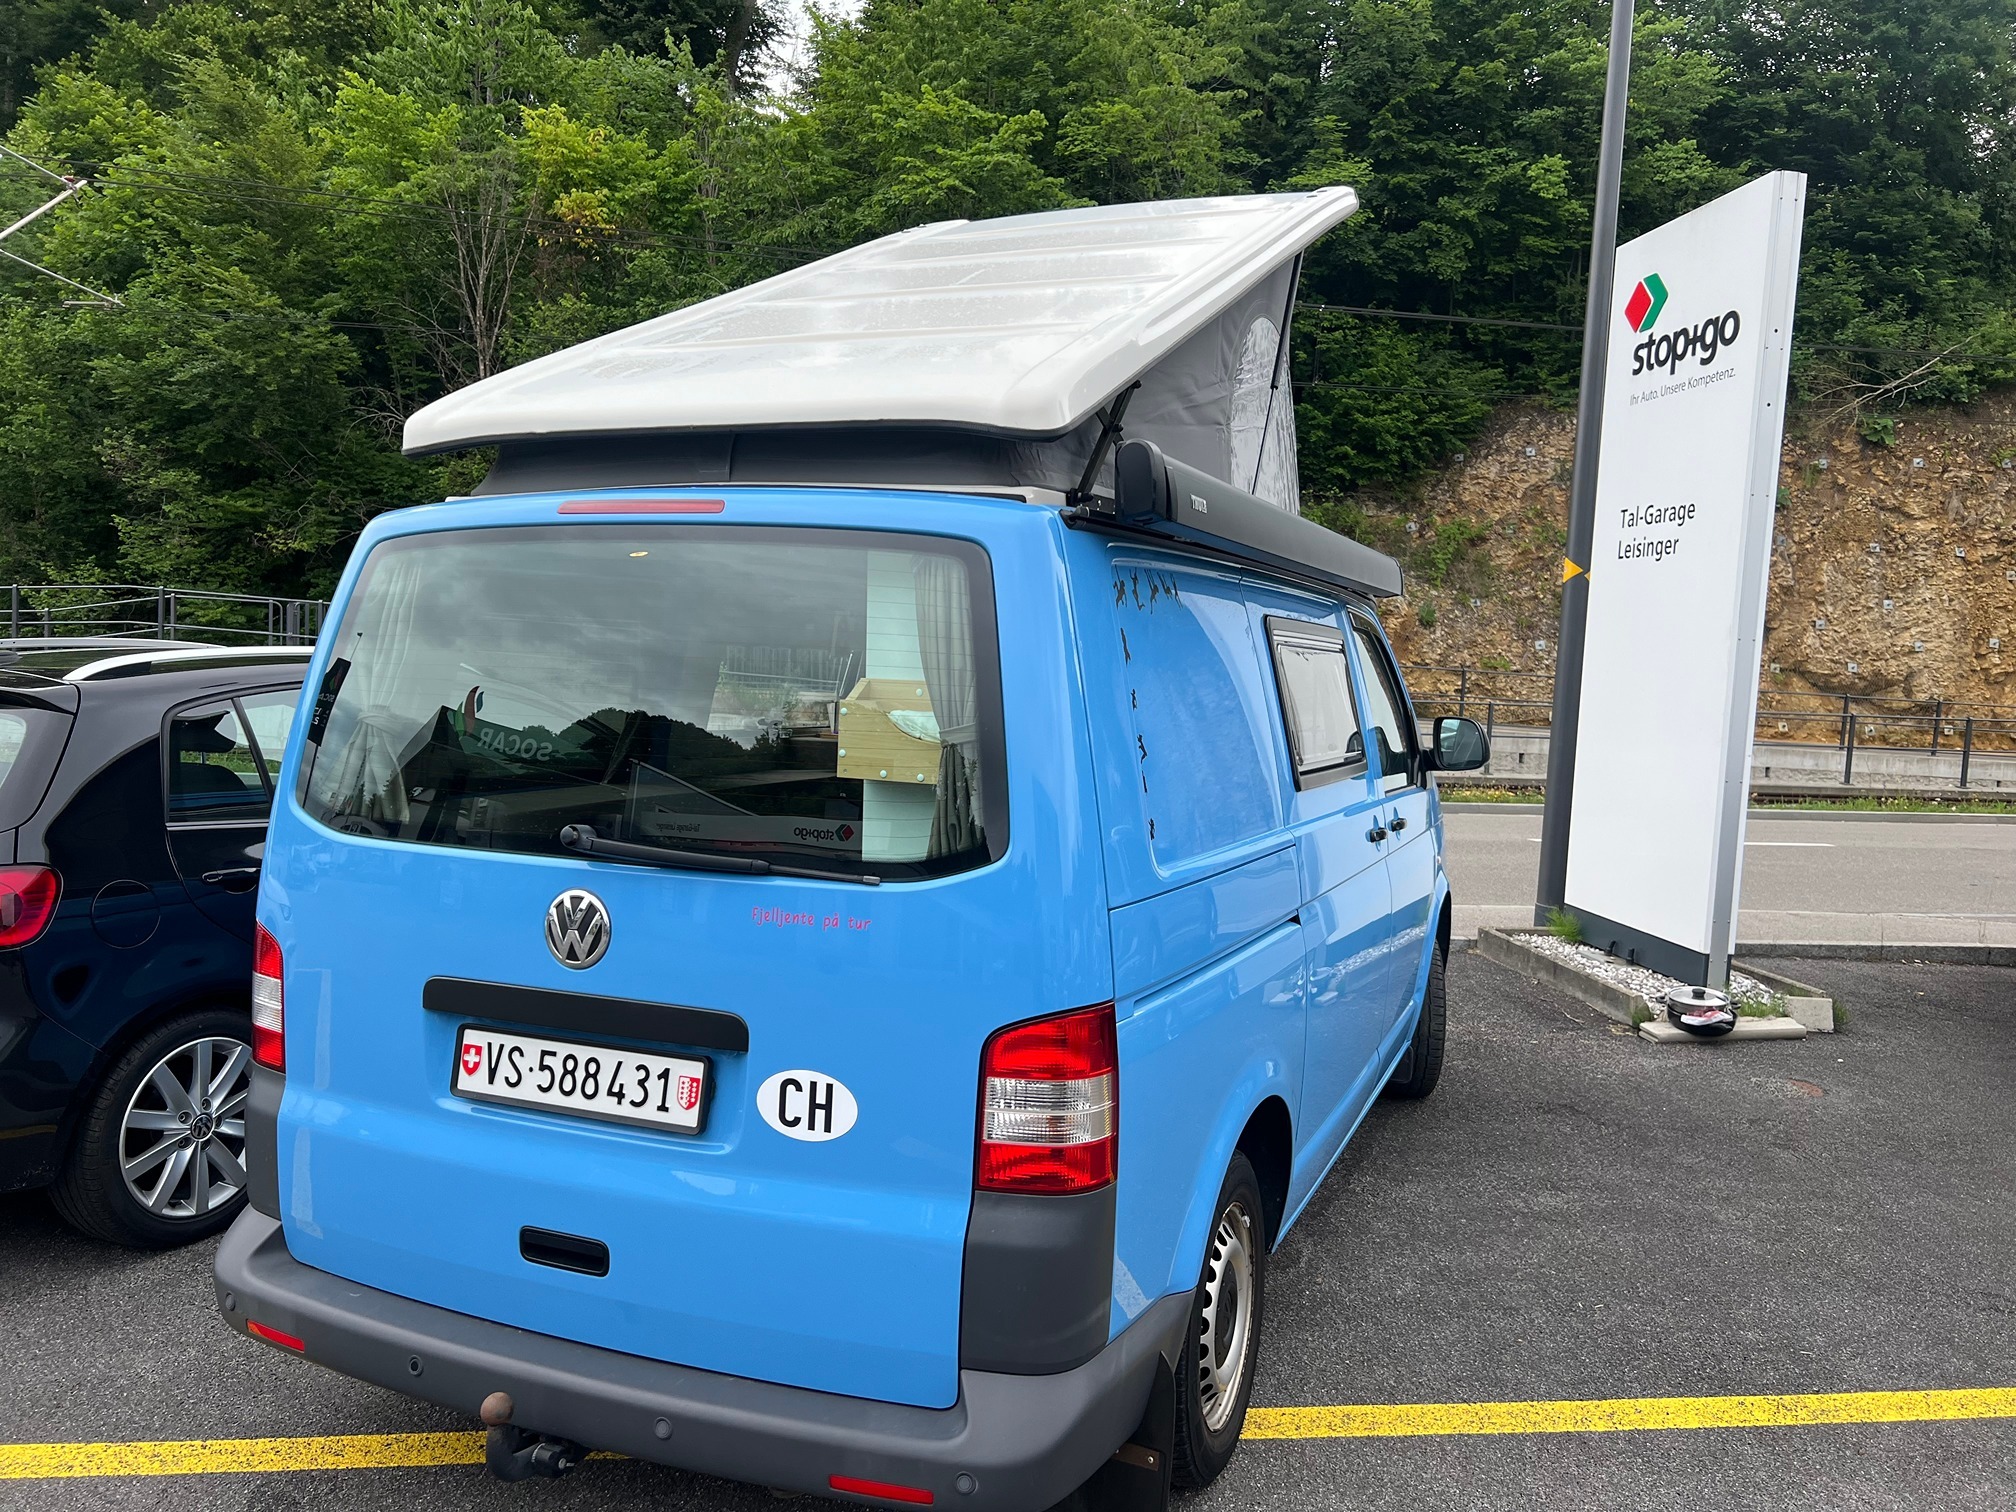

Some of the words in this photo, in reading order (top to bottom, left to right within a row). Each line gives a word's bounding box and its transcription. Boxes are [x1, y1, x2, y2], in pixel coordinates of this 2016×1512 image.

[1632, 310, 1741, 376] stop+go
[1630, 393, 1640, 406] Ihr
[1640, 390, 1659, 403] Auto.
[1660, 381, 1686, 397] Unsere
[1687, 367, 1736, 388] Kompetenz.
[1620, 501, 1696, 529] Tal-Garage
[1617, 536, 1679, 562] Leisinger
[752, 906, 814, 928] Fjelljente
[823, 912, 839, 931] på
[848, 917, 871, 930] tur
[778, 1077, 834, 1134] CH
